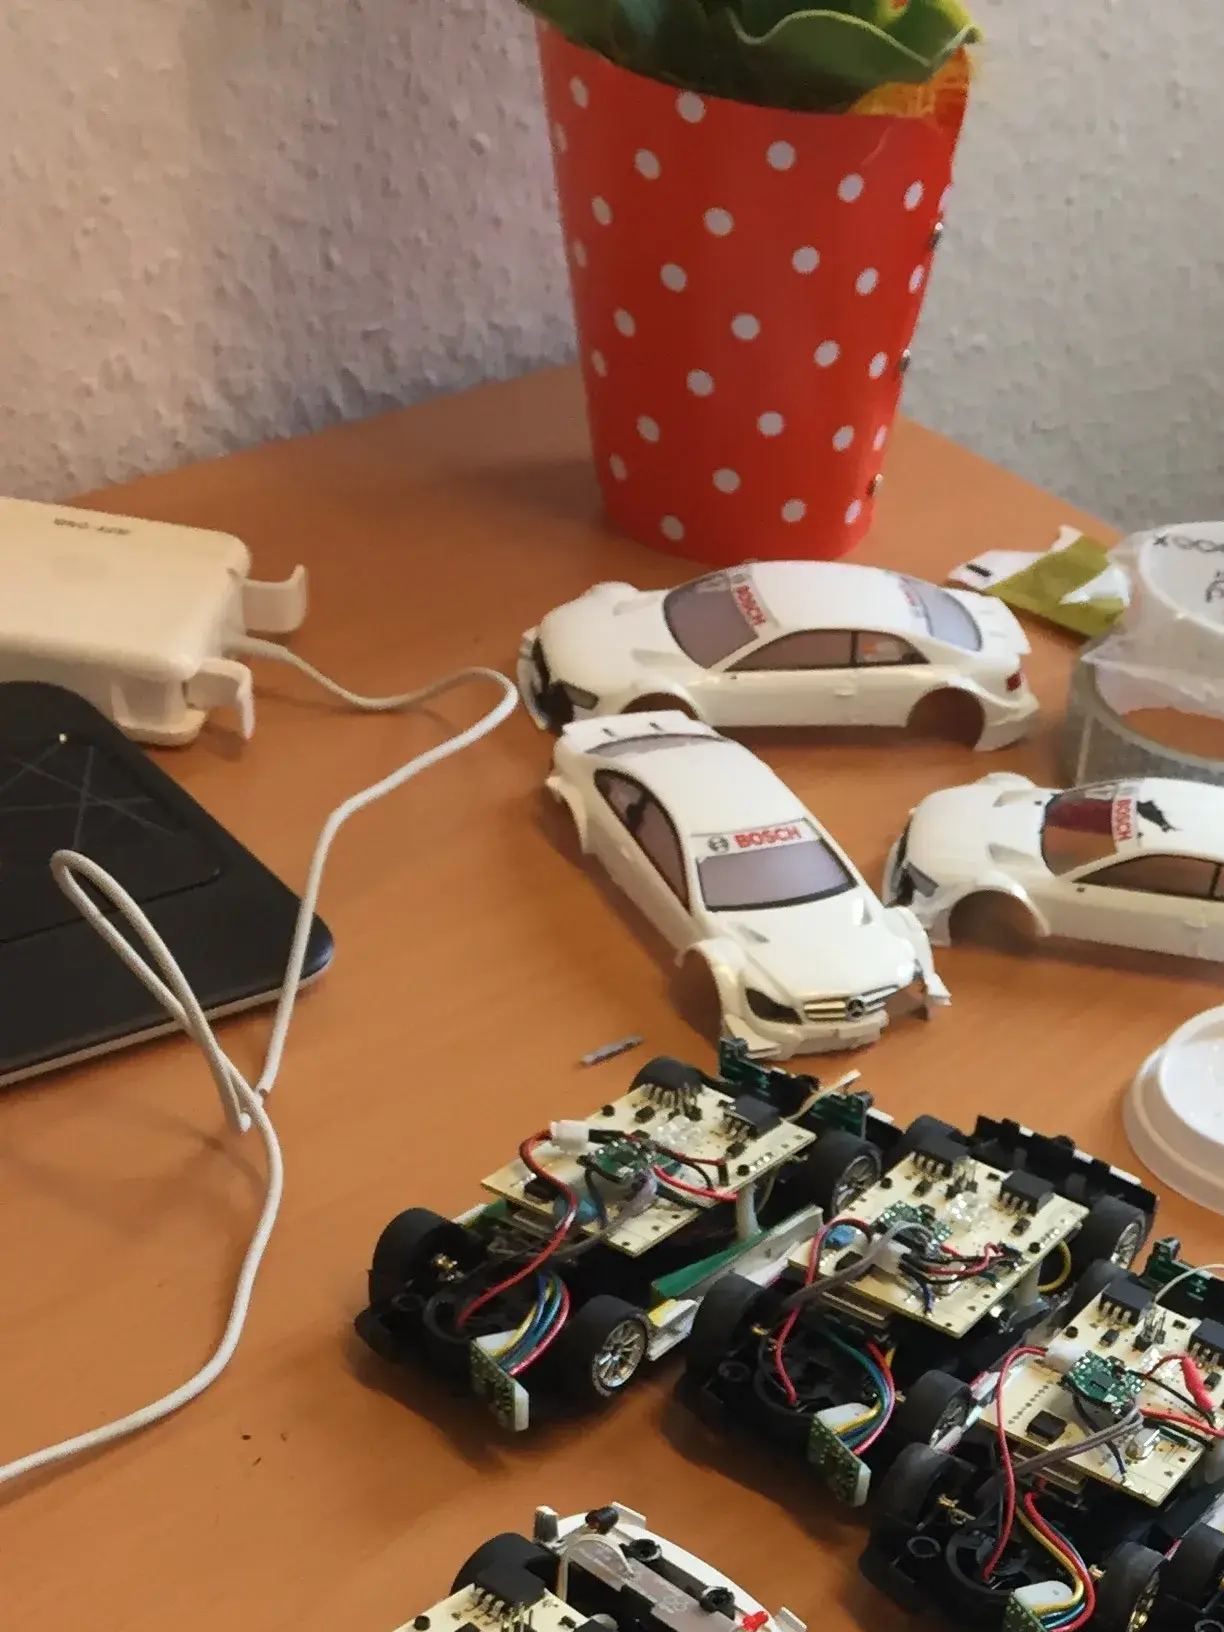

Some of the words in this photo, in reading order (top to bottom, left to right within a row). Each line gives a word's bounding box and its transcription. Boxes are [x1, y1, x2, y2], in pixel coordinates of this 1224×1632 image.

[736, 584, 766, 626] BOSCH
[734, 825, 803, 849] BOSCH
[1113, 798, 1134, 841] BOSCH
